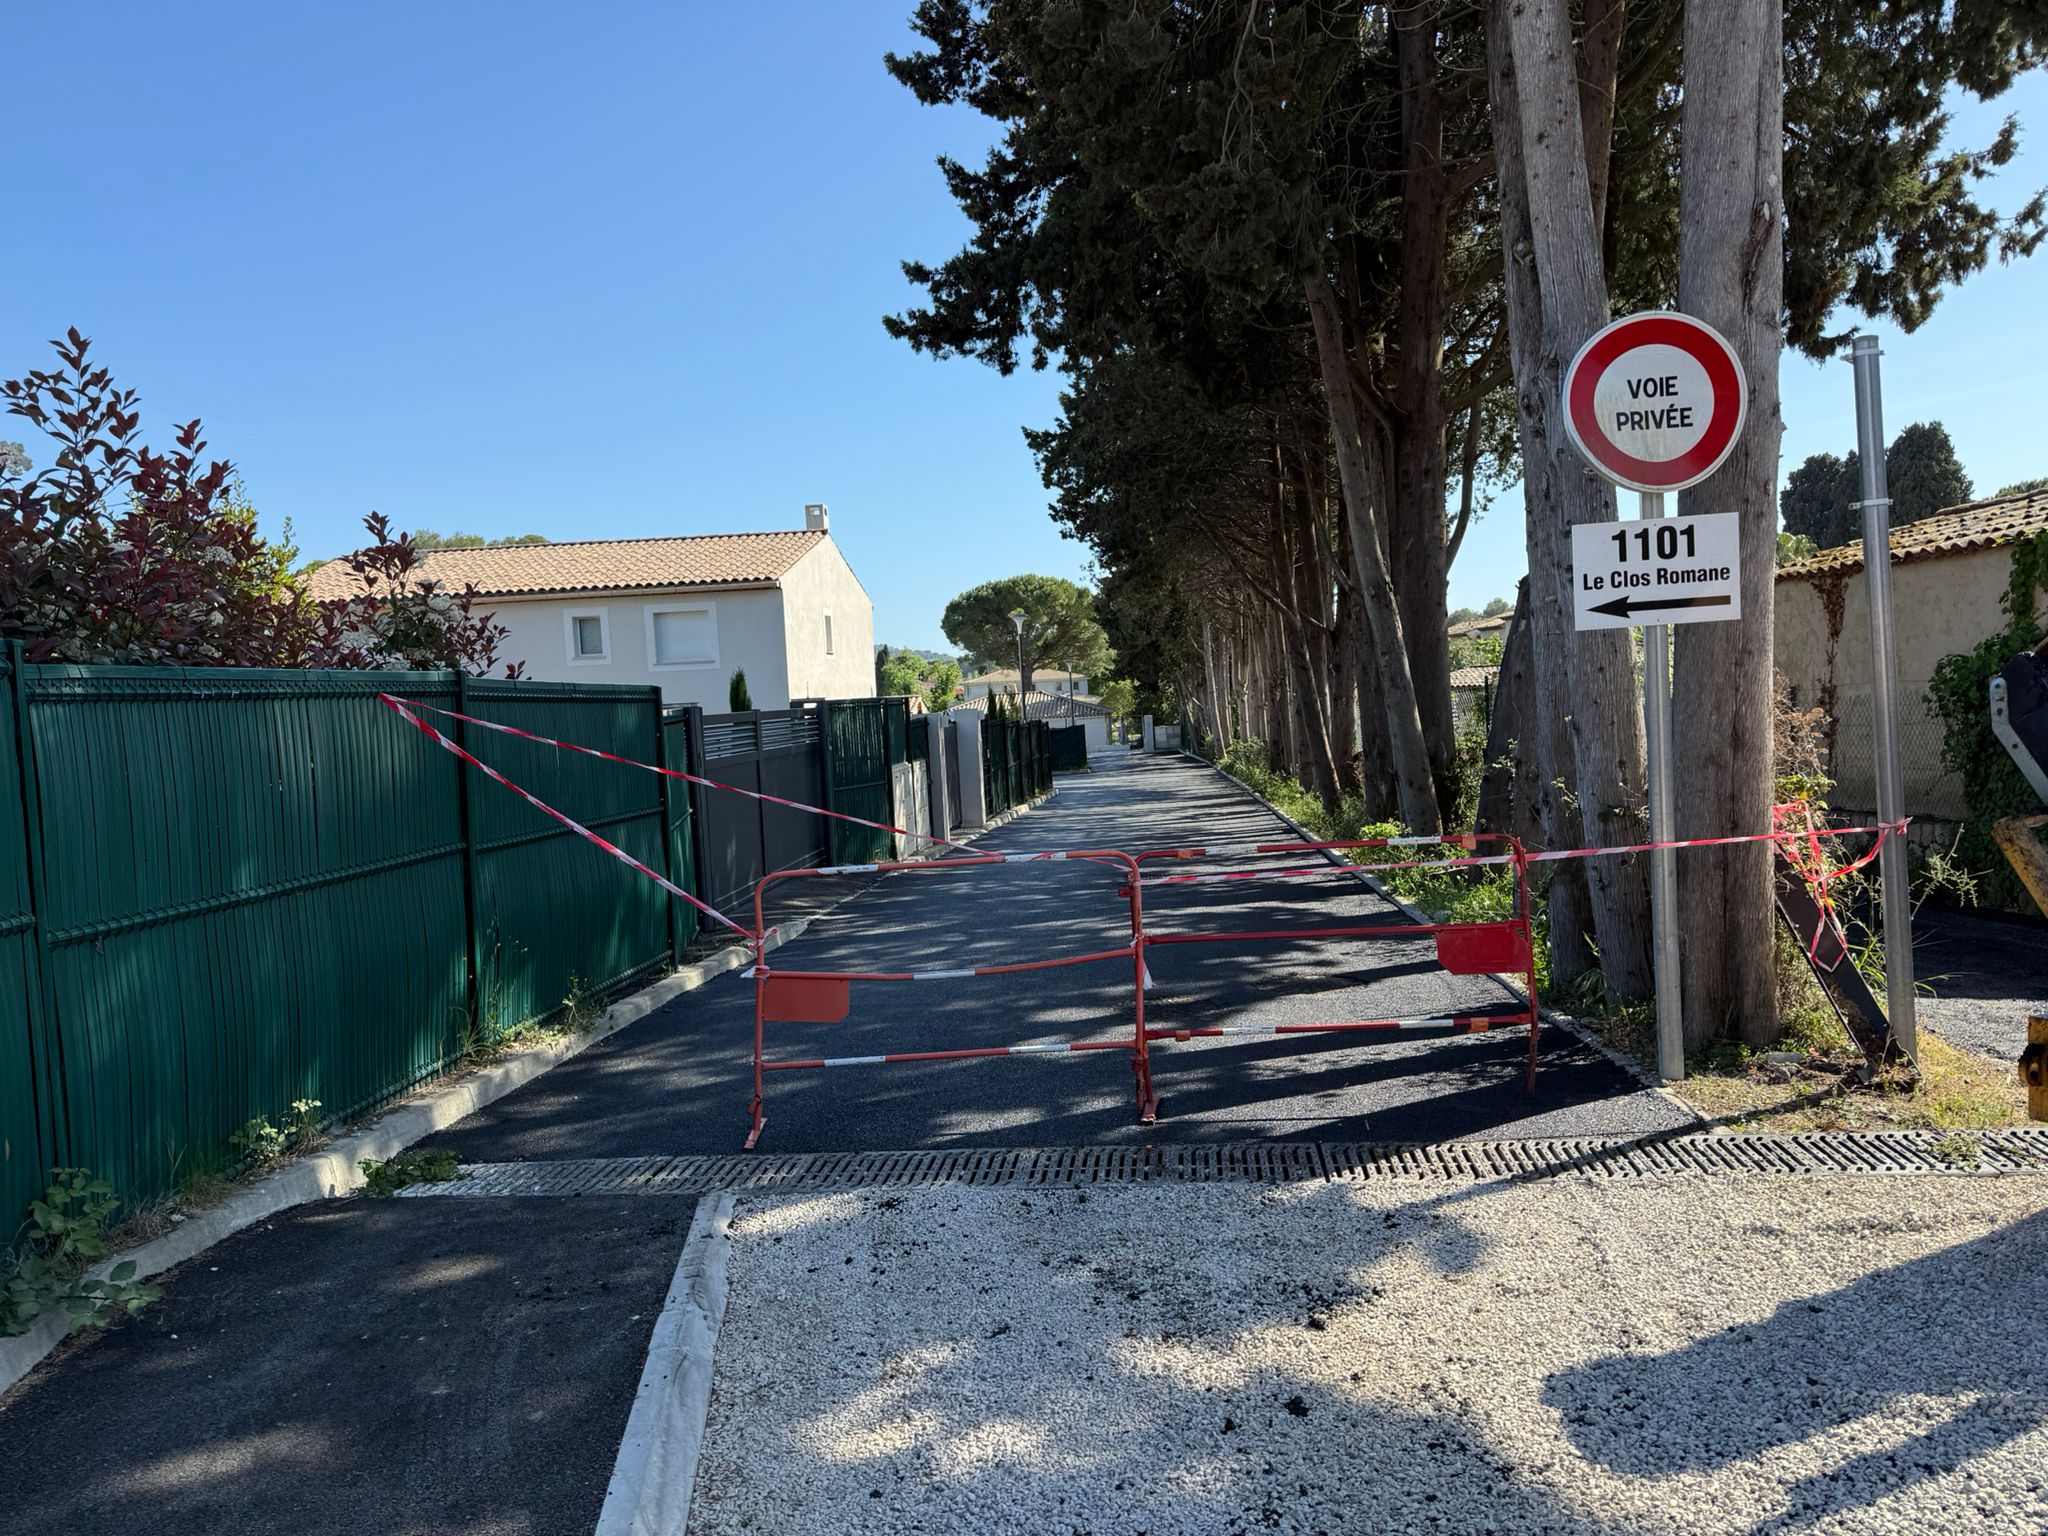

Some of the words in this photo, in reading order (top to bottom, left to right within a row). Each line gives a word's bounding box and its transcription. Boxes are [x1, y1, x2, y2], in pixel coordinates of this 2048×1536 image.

[1627, 376, 1678, 399] VOIE
[1616, 404, 1693, 431] PRIVÉE
[1611, 524, 1696, 562] 1101
[1583, 573, 1604, 591] Le
[1610, 569, 1651, 588] Clos
[1656, 566, 1731, 586] Romane
